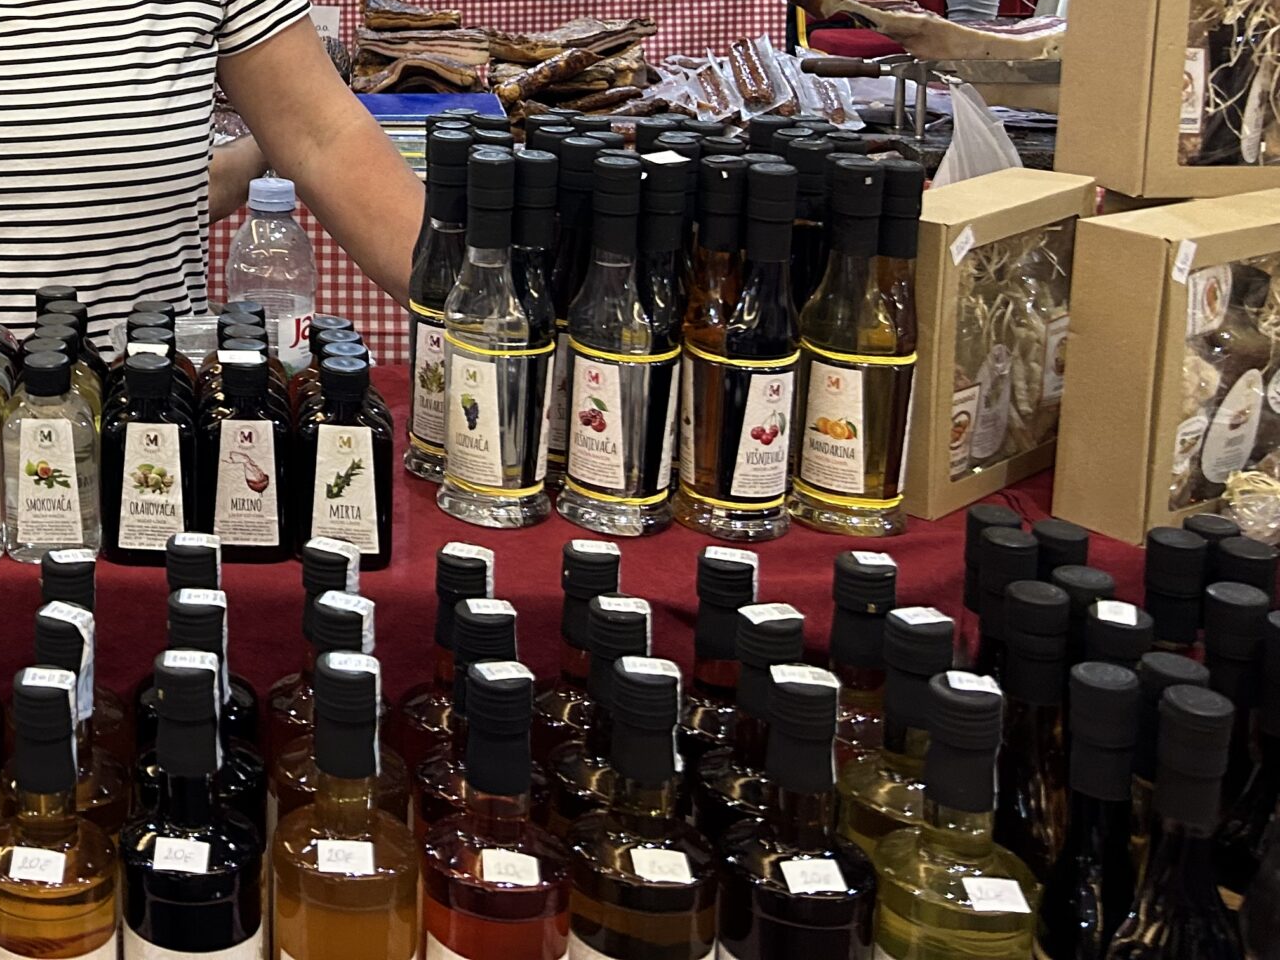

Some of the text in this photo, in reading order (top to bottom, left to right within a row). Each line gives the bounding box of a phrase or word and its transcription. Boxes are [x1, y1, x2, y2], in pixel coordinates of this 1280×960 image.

[809, 437, 855, 459] MANDARINA
[25, 495, 72, 511] SMOKOVAČA
[230, 498, 262, 512] MIRINO
[329, 504, 362, 520] MIRTA
